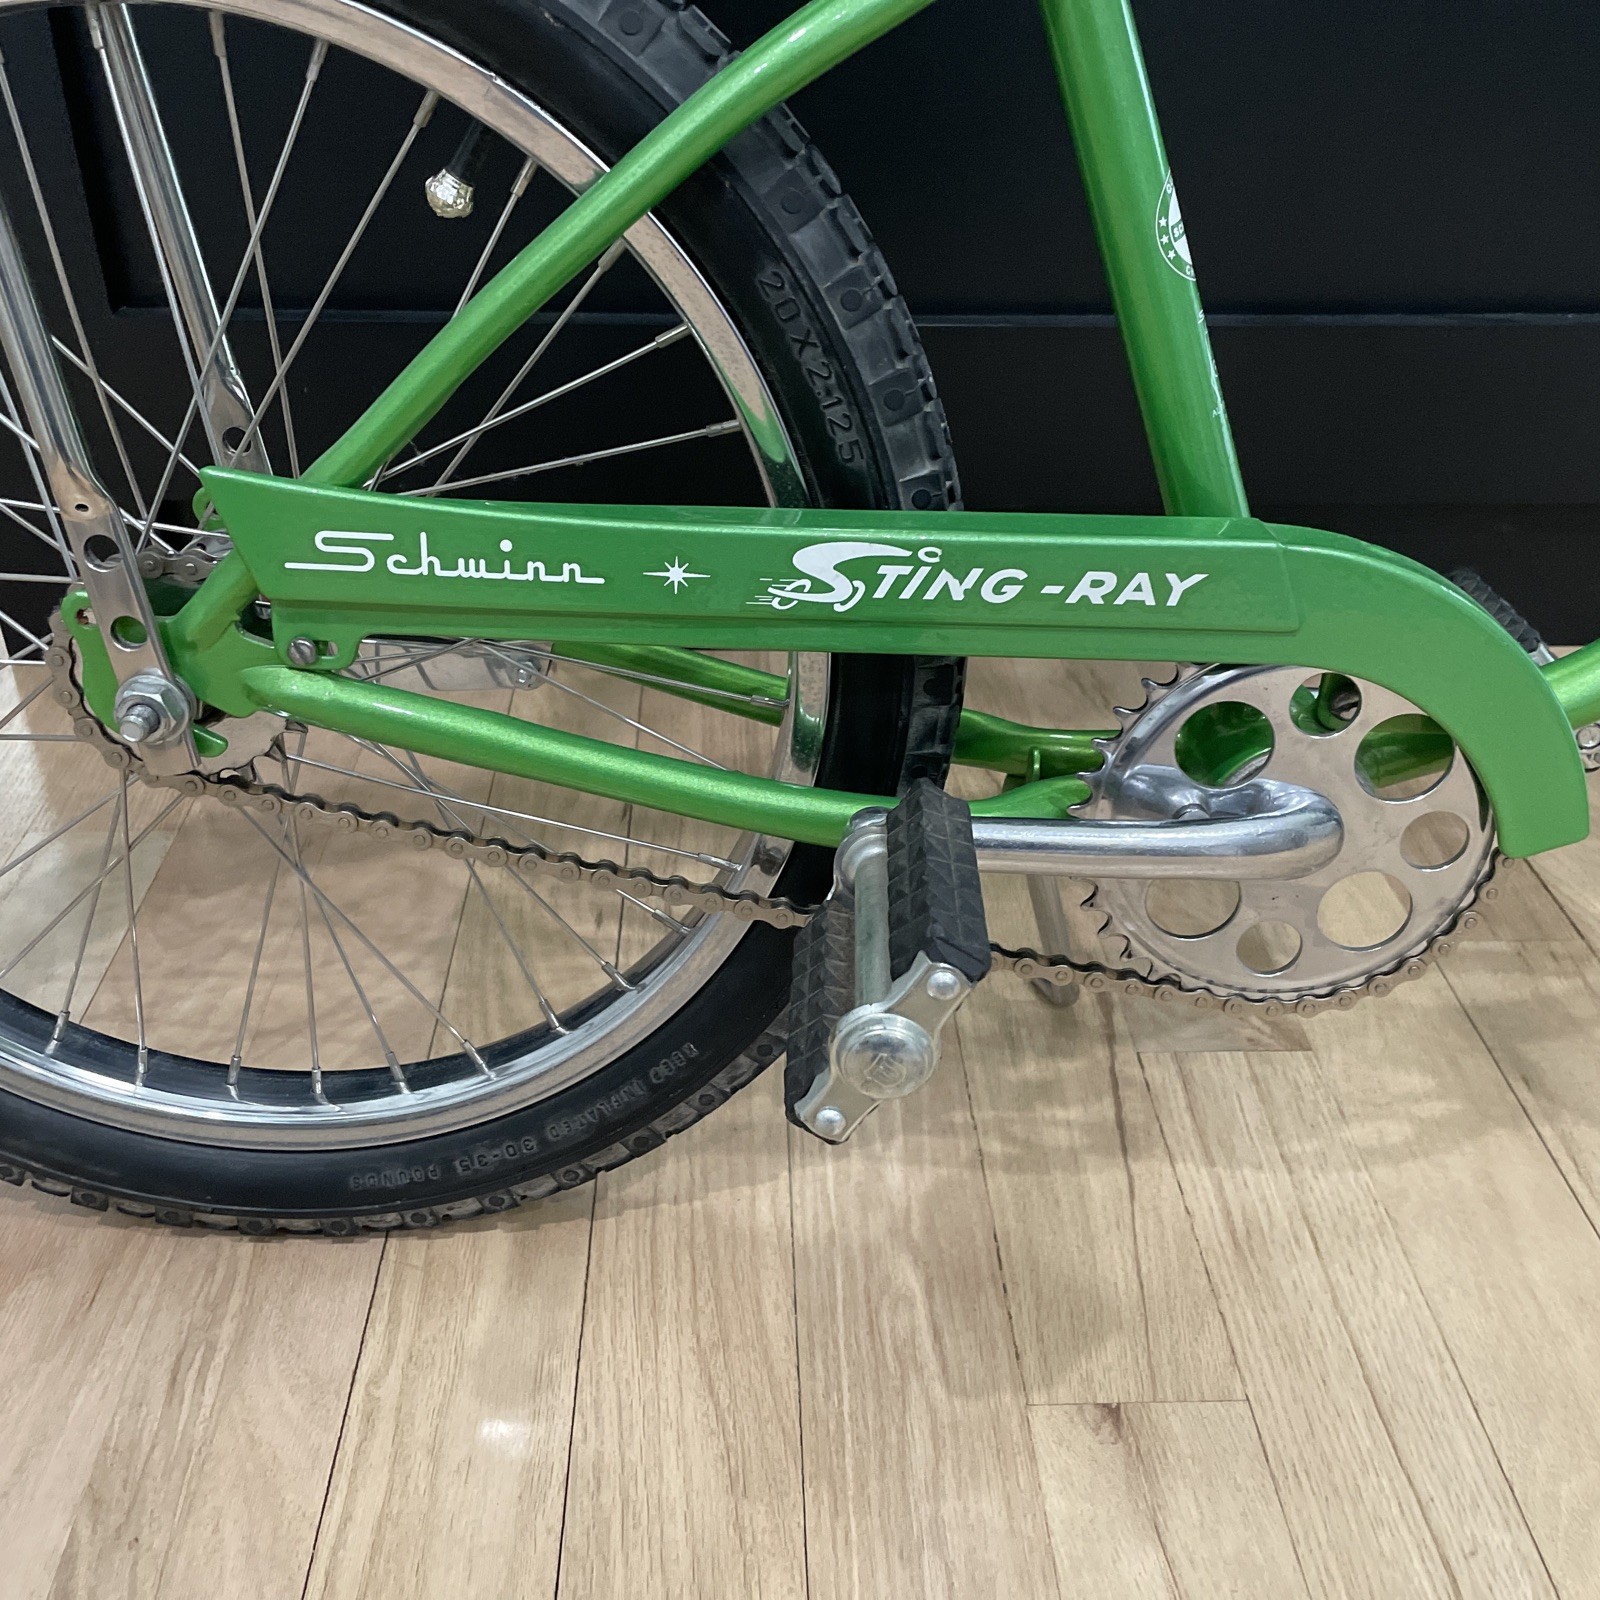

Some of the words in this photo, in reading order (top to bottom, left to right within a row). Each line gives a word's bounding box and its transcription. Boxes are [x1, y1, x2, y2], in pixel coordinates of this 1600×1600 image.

[284, 529, 606, 584] Schwinn
[548, 1079, 647, 1140] INFLATED
[350, 1165, 440, 1190] POUNDS
[456, 1137, 538, 1174] 30-35
